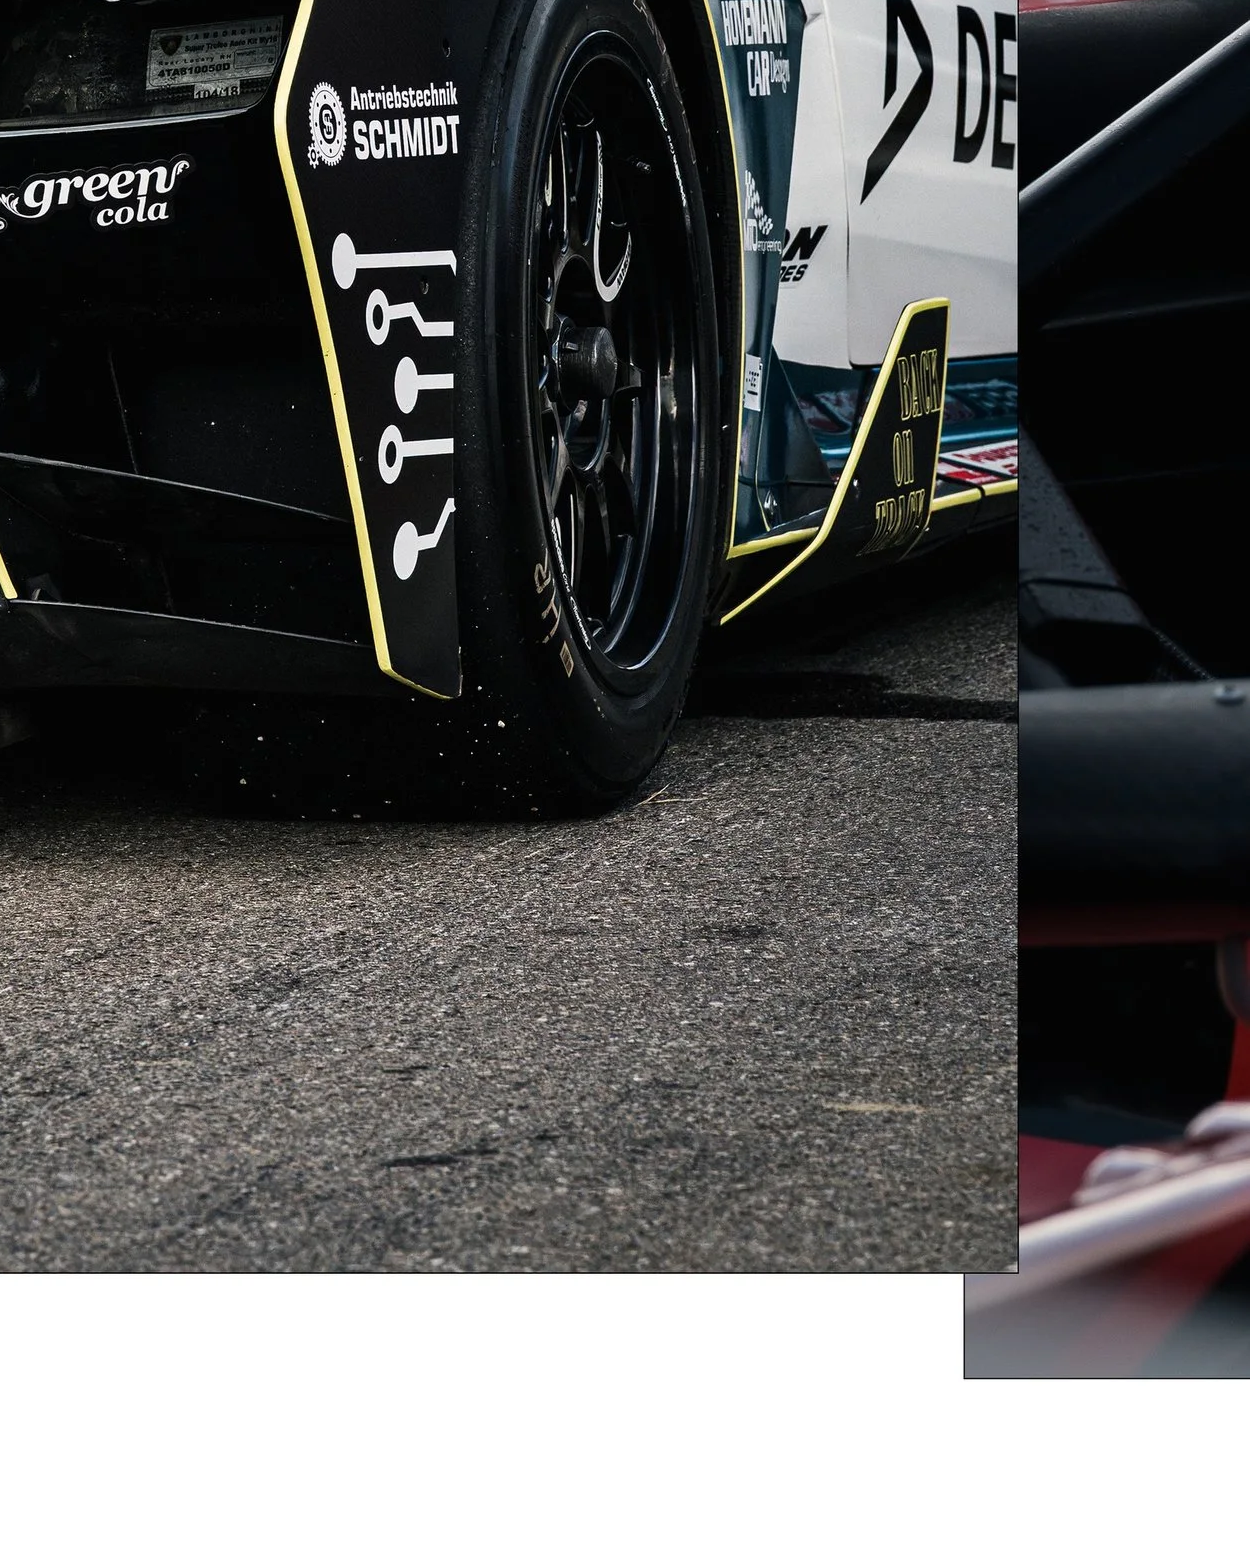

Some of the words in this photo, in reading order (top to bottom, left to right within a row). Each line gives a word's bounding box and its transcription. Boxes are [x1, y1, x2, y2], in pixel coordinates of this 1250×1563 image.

[721, 0, 787, 46] HOVEMANN
[350, 82, 458, 111] Antriebstechnik
[746, 51, 771, 97] CAR
[770, 51, 791, 93] Design
[354, 115, 460, 160] SCHMIDT
[2, 159, 190, 219] green
[96, 196, 169, 227] cola
[897, 348, 941, 421] BACK
